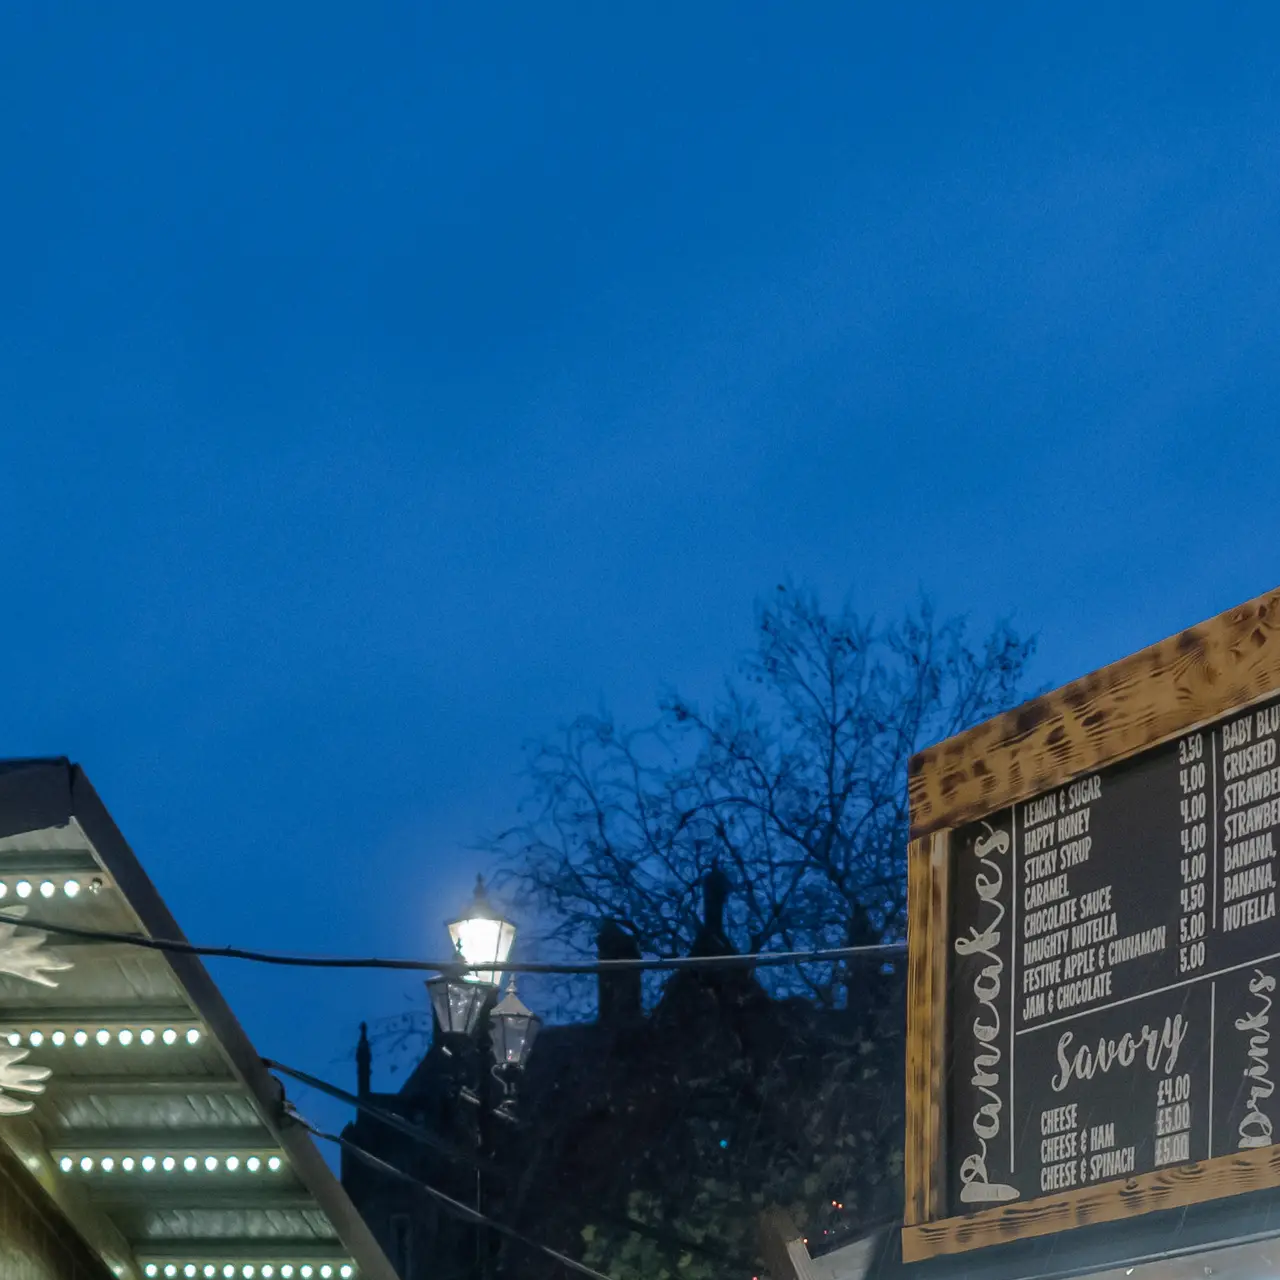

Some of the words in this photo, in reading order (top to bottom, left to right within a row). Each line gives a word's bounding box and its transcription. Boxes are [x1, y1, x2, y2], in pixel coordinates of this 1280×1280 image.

[1222, 715, 1253, 751] BABY
[1223, 738, 1276, 781] CRUSHED
[1024, 793, 1056, 828] LEMON
[1069, 775, 1102, 809] SUGAR
[1180, 733, 1203, 764] 3.50
[1024, 822, 1055, 855] HAPPY
[1058, 807, 1091, 842] HONEY
[1180, 762, 1206, 794] 4.00
[1024, 849, 1057, 883] STICKY
[1060, 836, 1092, 870] SYRUP
[1180, 793, 1206, 823] 4.00
[1024, 873, 1070, 910] CARAMEL
[1180, 823, 1206, 853] 4.00
[1223, 839, 1276, 873] BANANA,
[1024, 898, 1077, 938] CHOCOLATE
[1080, 885, 1112, 919] SAUCE
[1180, 853, 1206, 883] 4.00
[1024, 929, 1069, 966] NAUGHTY
[1072, 912, 1118, 949] NUTELLA
[1180, 882, 1205, 913] 4.50
[1223, 868, 1276, 903] BANANA,
[1223, 890, 1276, 934] NUTELLA
[1023, 993, 1045, 1021] JAM
[1057, 971, 1112, 1010] CHOCOLATE
[1180, 942, 1205, 973] 5.00
[1024, 960, 1061, 993] FESTIVE
[1064, 948, 1095, 980] APPLE
[1108, 925, 1166, 966] CINNAMON
[1180, 912, 1205, 943] 5.00
[954, 820, 1020, 1203] Pancakes
[1052, 1014, 1189, 1092] Savory
[1235, 969, 1276, 1148] Drinks
[1041, 1103, 1078, 1136] CHEESE
[1157, 1074, 1190, 1106] £4.00
[1041, 1132, 1077, 1164] CHEESE
[1090, 1123, 1115, 1152] HAM
[1157, 1101, 1190, 1136] £5.00
[1041, 1160, 1077, 1191] CHEESE
[1090, 1146, 1135, 1181] SPINACH
